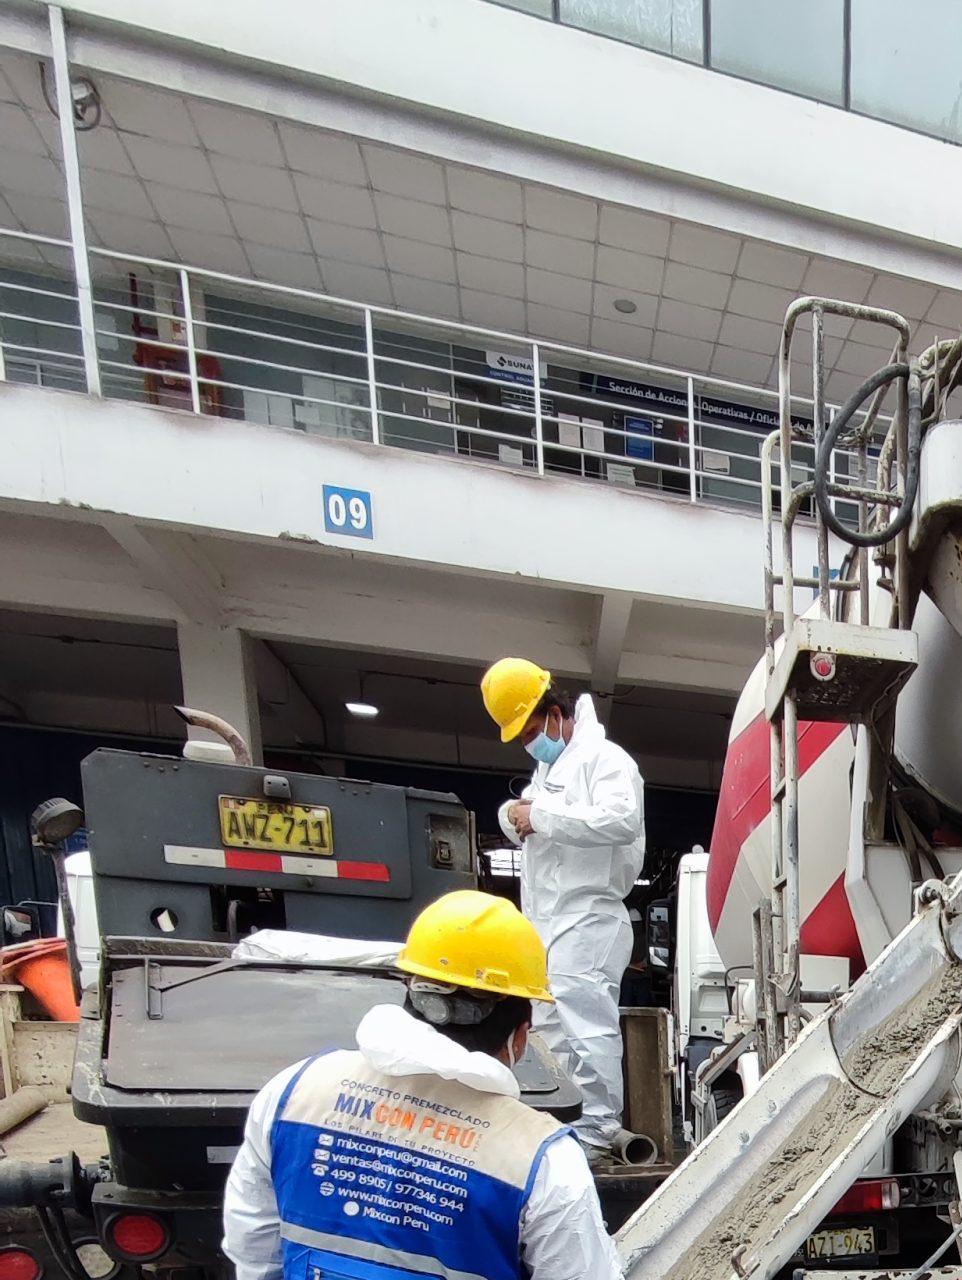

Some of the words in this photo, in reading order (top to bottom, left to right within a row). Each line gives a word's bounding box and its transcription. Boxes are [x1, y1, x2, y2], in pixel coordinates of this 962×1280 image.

[507, 360, 534, 372] SUNA
[609, 381, 644, 397] Sección
[645, 390, 656, 400] de
[702, 402, 749, 420] Operativas
[329, 494, 367, 529] 09
[228, 811, 328, 848] AWZ-711
[341, 1079, 401, 1101] CONCRETO
[403, 1094, 491, 1129] PREMEZCLADO
[332, 1152, 468, 1198] ventas@mixconperu.com
[337, 1137, 468, 1182] mixconperu@gmail.com
[421, 1144, 476, 1167] PROYECTO
[330, 1168, 356, 1182] 499
[395, 1183, 437, 1204] 977346
[439, 1197, 465, 1213] 944
[337, 1187, 454, 1226] www.mixconperu.com
[363, 1206, 401, 1225] Mixcon
[403, 1215, 430, 1231] Peru
